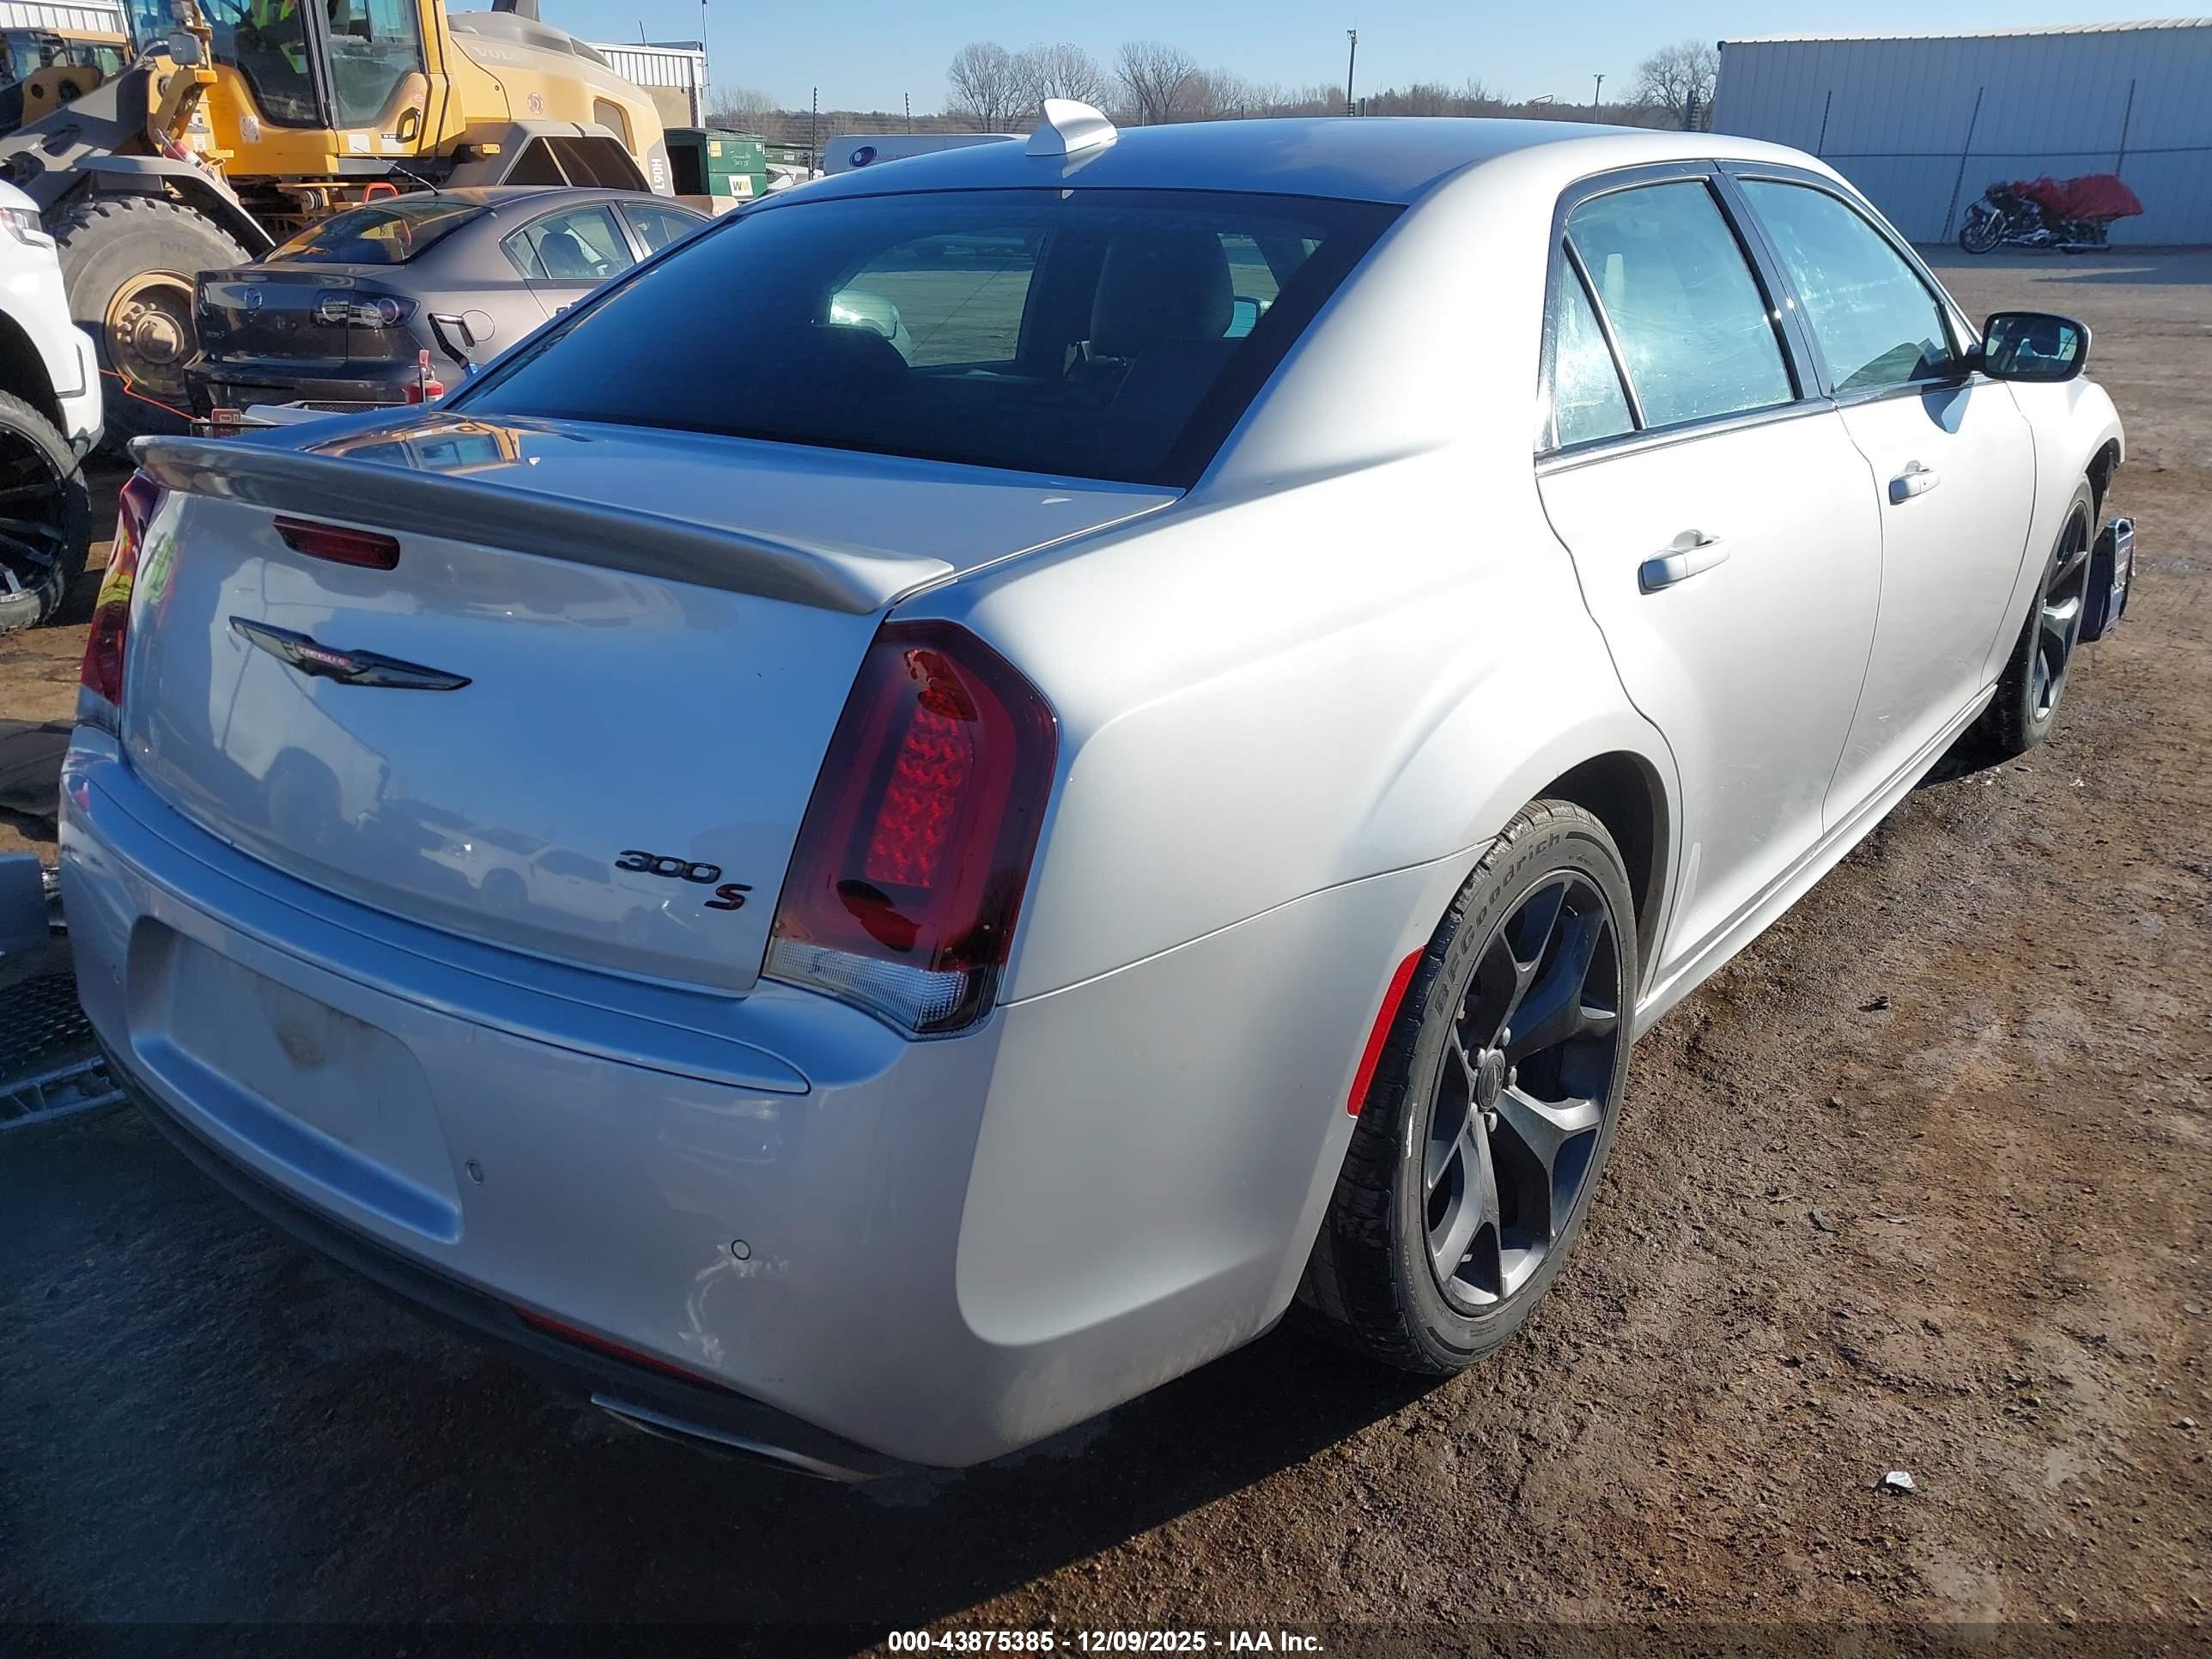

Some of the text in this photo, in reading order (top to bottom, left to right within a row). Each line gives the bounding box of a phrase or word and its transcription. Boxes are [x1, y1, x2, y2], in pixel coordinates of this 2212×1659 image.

[651, 158, 665, 190] L90H
[732, 180, 750, 191] WM
[615, 849, 721, 884] 300
[703, 884, 753, 911] S
[1434, 832, 1560, 1018] BFGoodrich
